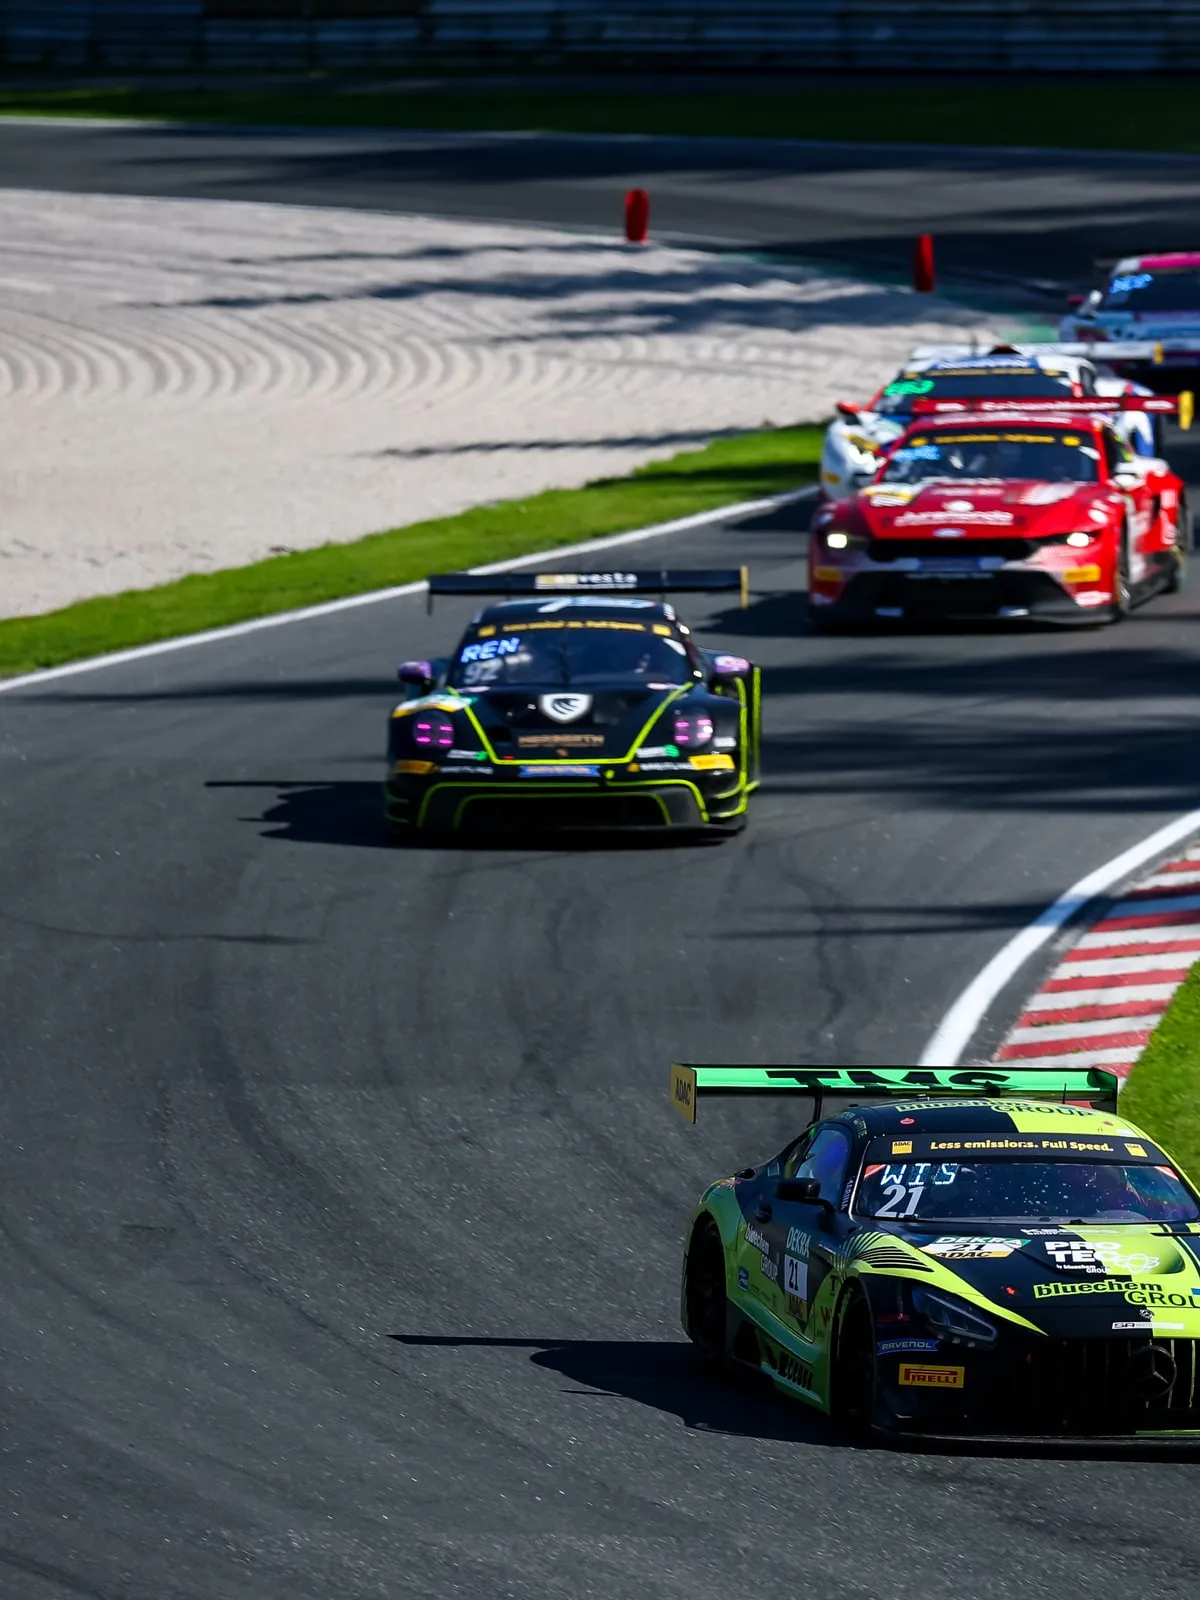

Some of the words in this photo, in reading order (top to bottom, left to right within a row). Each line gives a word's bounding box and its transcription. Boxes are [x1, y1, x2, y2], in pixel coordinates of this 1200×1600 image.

[460, 637, 520, 663] REN
[930, 1140, 961, 1150] Less
[964, 1139, 1038, 1150] emissions.
[1042, 1140, 1067, 1150] Full
[1070, 1141, 1114, 1152] Speed.
[875, 1184, 925, 1218] 21
[744, 1222, 770, 1256] bluechem
[786, 1226, 811, 1259] DEKRA
[935, 1236, 1023, 1248] DEKRA
[949, 1243, 986, 1252] 21
[1044, 1241, 1122, 1251] PRO
[760, 1252, 778, 1283] GROUP
[788, 1258, 800, 1292] 21
[1036, 1280, 1163, 1297] bluechem
[881, 1341, 932, 1350] RAVENOL
[903, 1367, 958, 1384] PIRELLI
